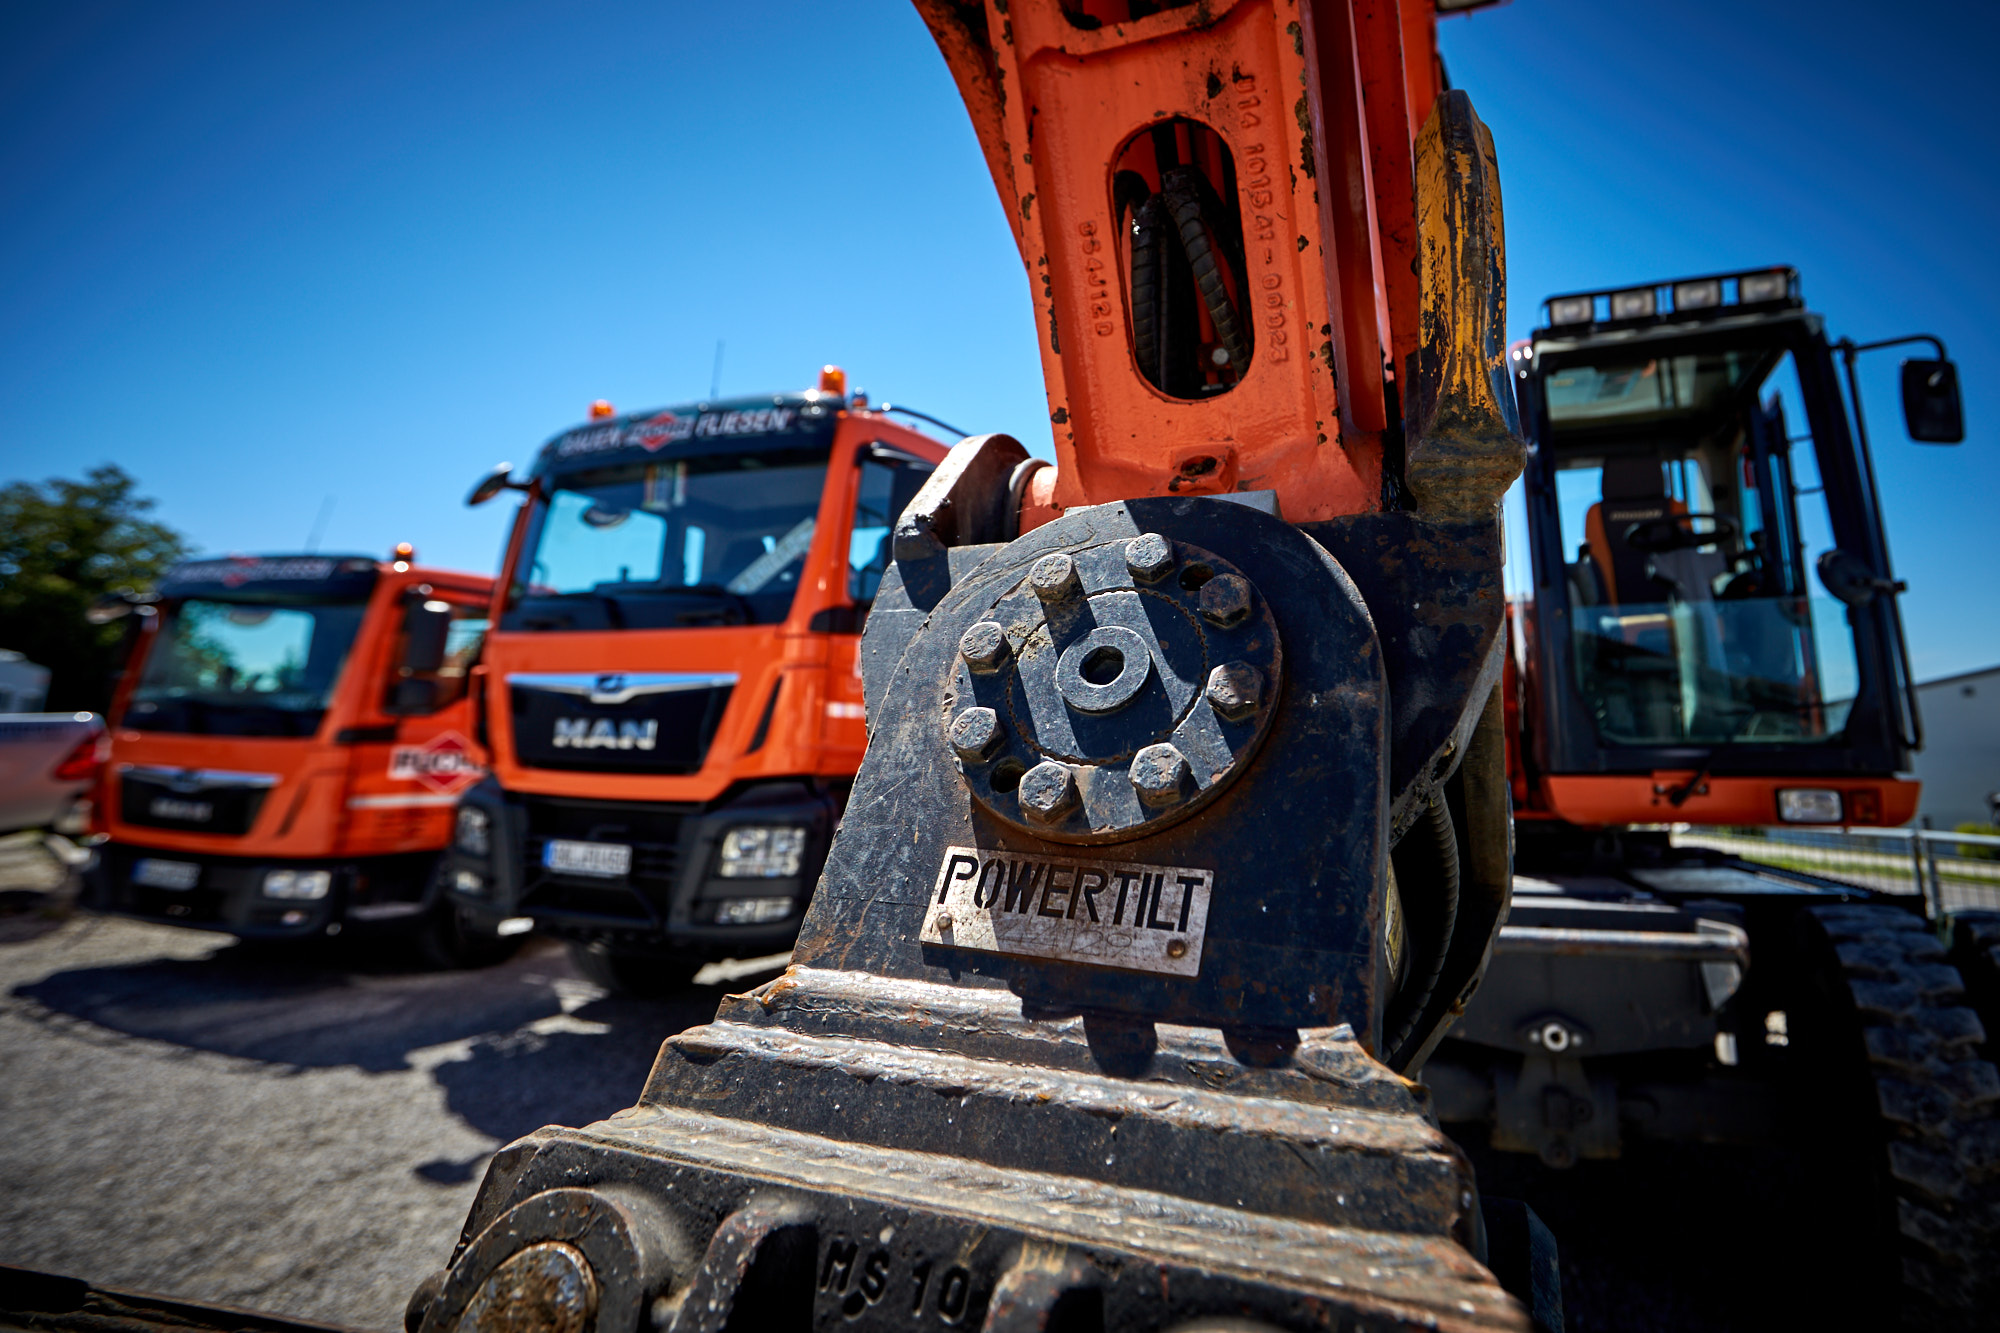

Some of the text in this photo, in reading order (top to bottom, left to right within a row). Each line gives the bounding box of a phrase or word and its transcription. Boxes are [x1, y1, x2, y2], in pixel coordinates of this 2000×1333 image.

[695, 408, 793, 437] FLIESEN
[552, 718, 659, 750] MAN
[936, 854, 1205, 933] POWERTILT
[819, 1239, 971, 1326] MS 10
